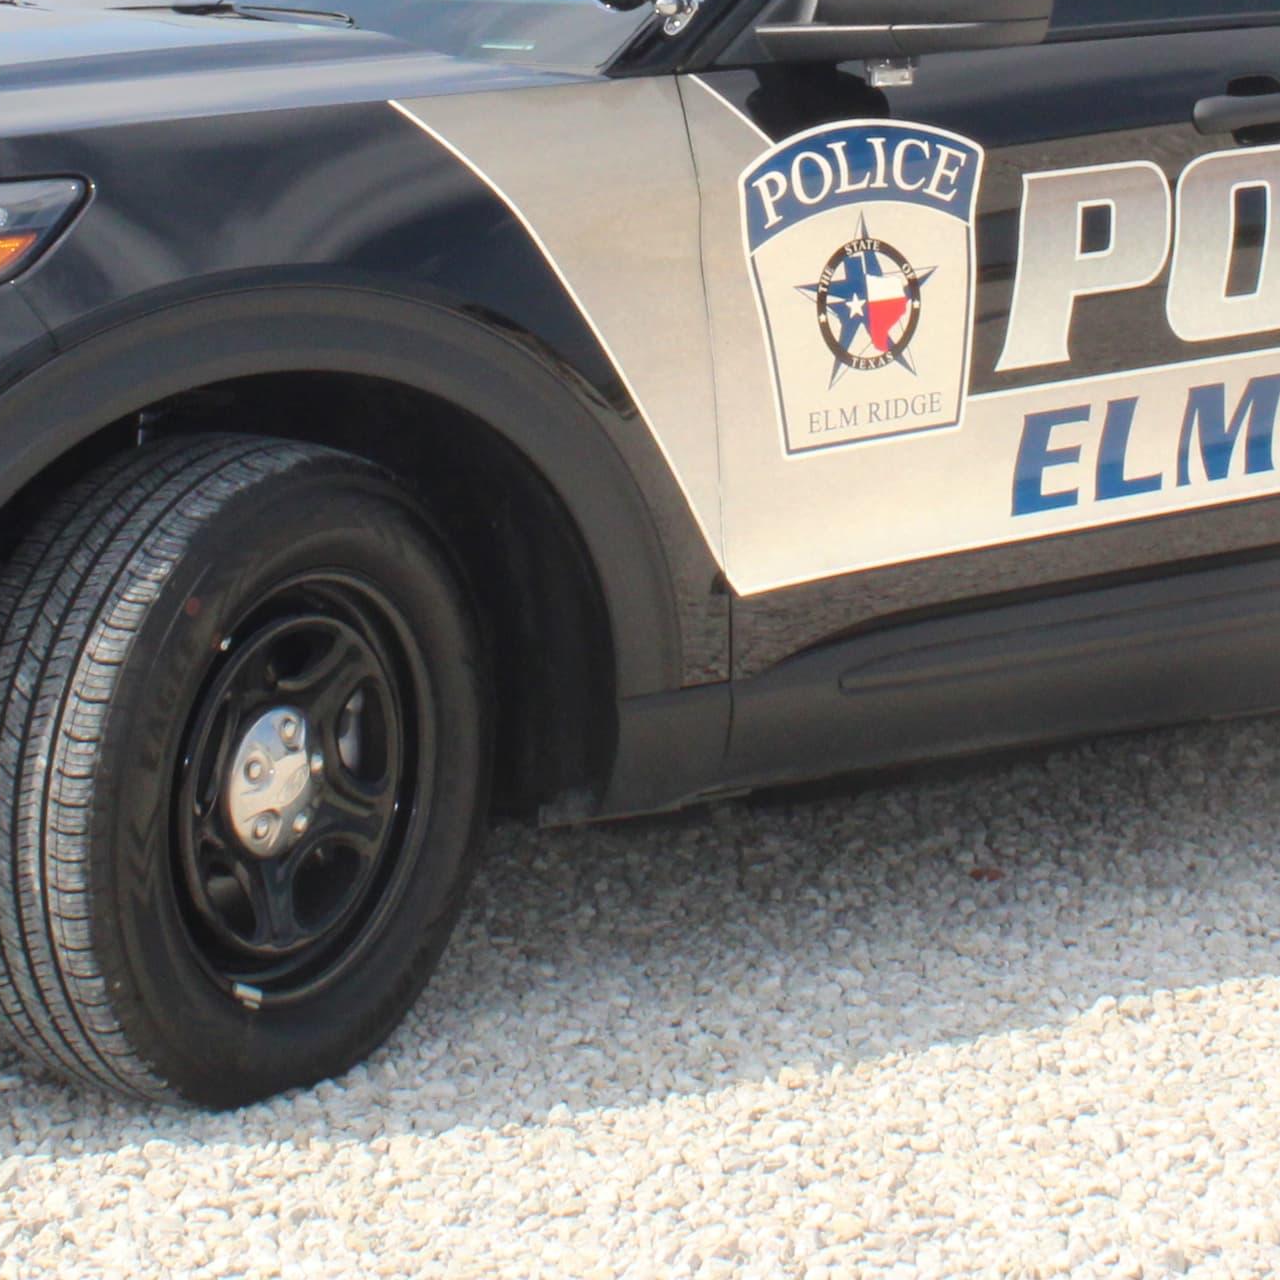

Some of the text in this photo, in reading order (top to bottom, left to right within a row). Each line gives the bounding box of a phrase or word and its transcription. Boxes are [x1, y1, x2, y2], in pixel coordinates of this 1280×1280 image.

[752, 137, 967, 230] POLICE
[818, 239, 916, 370] THE STATE OF TEXAS
[808, 392, 943, 434] ELM RIDGE
